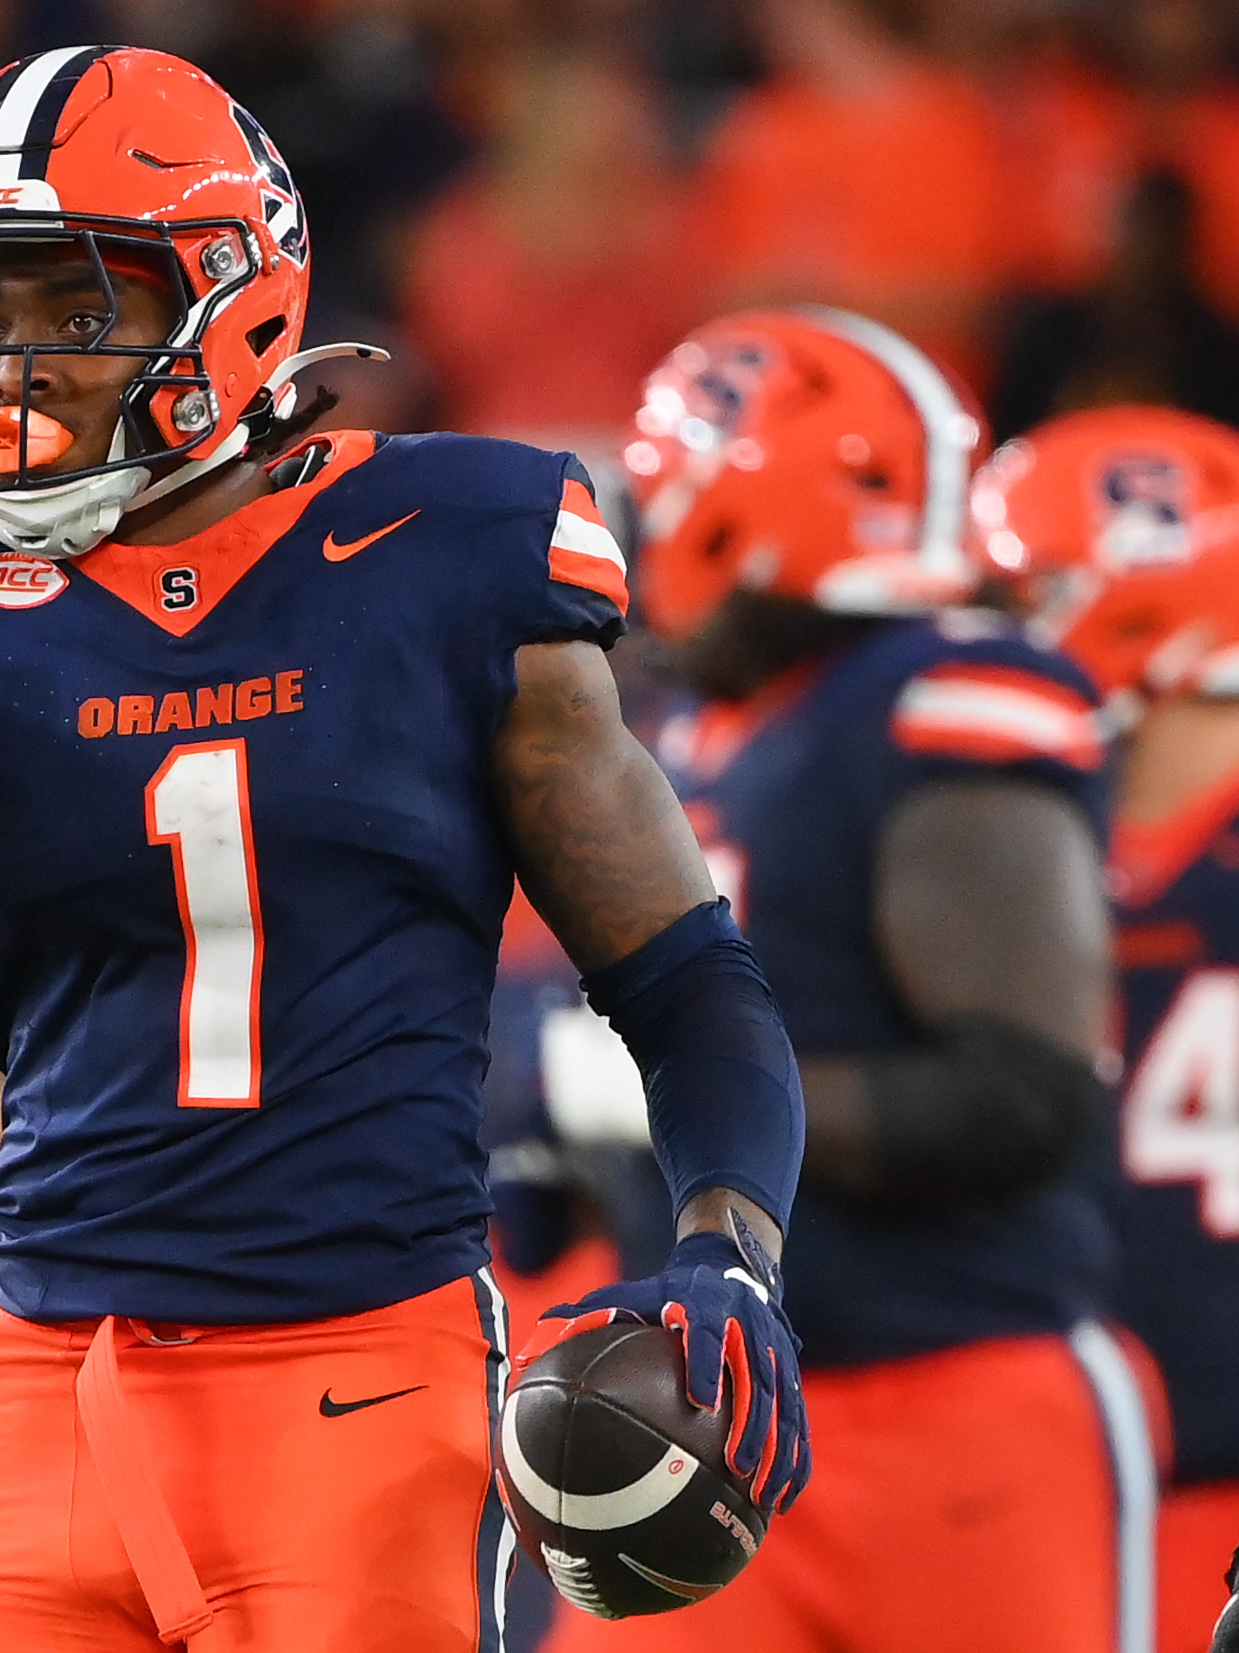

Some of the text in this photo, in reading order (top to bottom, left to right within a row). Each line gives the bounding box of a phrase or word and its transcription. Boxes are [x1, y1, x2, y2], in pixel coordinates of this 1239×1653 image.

[160, 567, 197, 612] S
[77, 669, 304, 739] ORANGE
[144, 737, 264, 1108] 1
